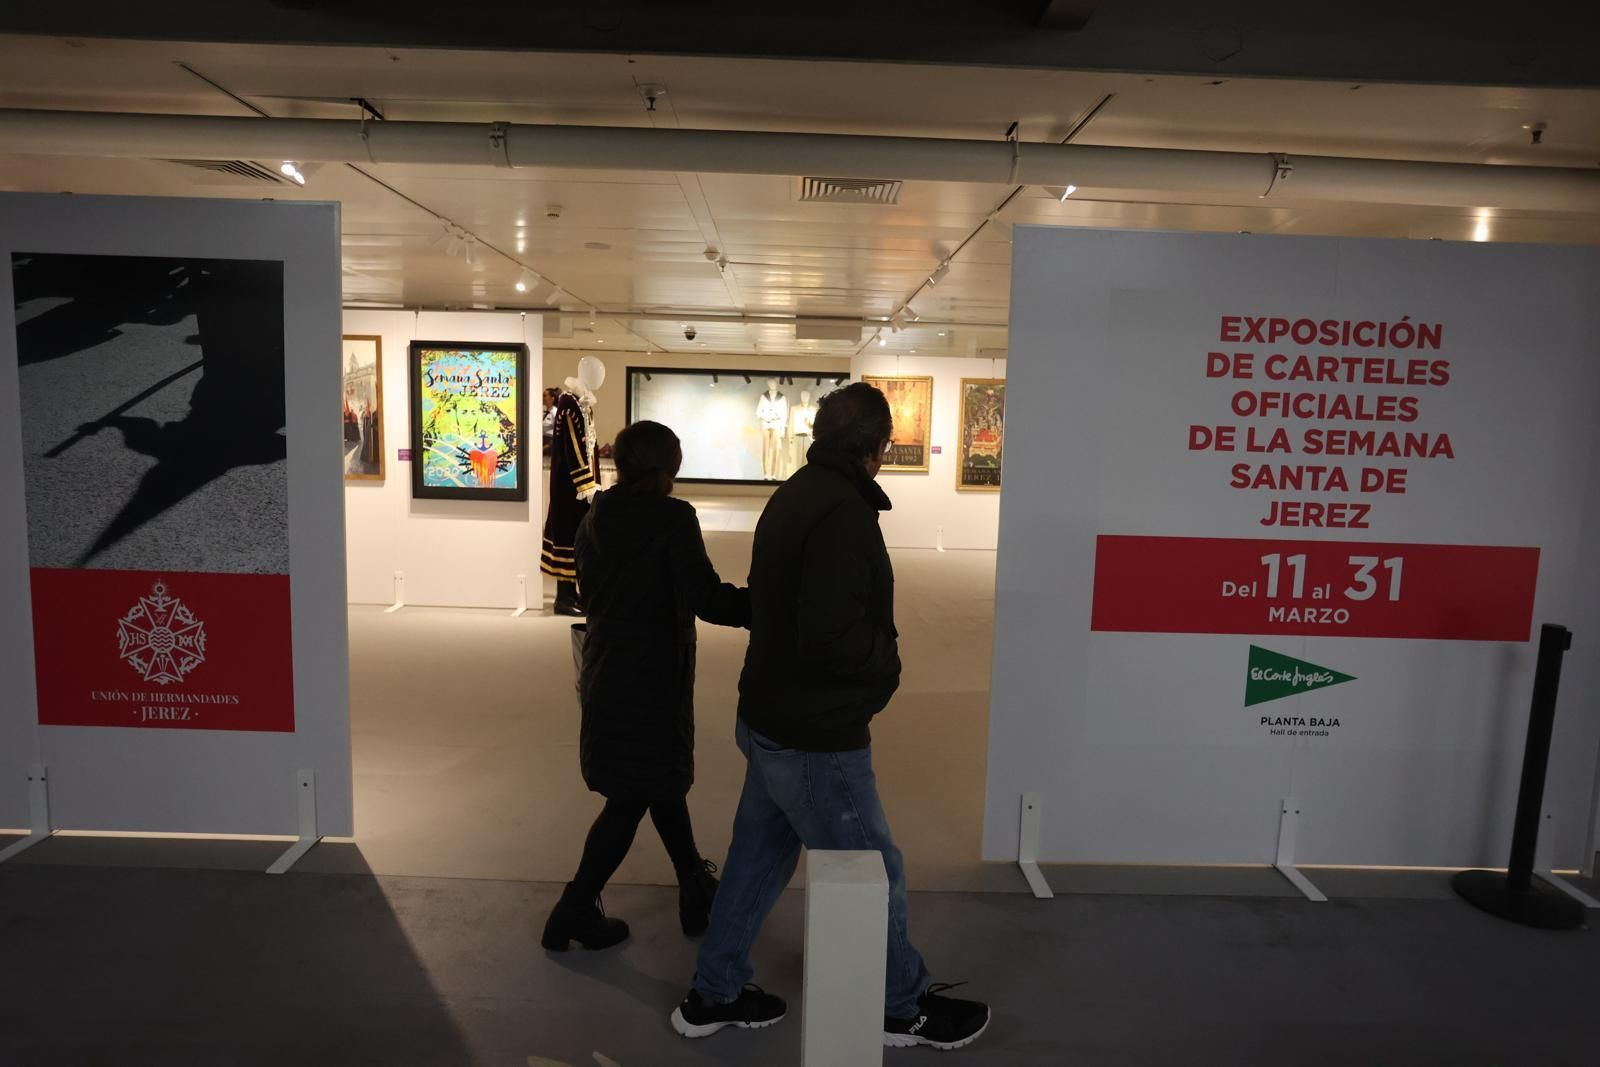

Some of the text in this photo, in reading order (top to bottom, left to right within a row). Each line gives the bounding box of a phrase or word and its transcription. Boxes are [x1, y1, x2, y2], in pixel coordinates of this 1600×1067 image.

[1220, 315, 1442, 349] EXPOSICIÓN
[1206, 352, 1450, 386] DE CARTELES
[1231, 390, 1419, 422] OFICIALES
[1188, 425, 1455, 459] DE LA SEMANA
[1230, 463, 1408, 494] SANTA DE
[1260, 501, 1371, 528] JEREZ
[1221, 553, 1404, 601] Del 11 al 31
[1268, 607, 1350, 624] MARZO
[1263, 668, 1292, 681] Corte
[91, 689, 239, 704] UNIÓN DE HERMANDADES
[141, 706, 191, 721] JEREZ
[1260, 716, 1340, 727] PLANTA BAJA
[1270, 728, 1286, 736] Hall
